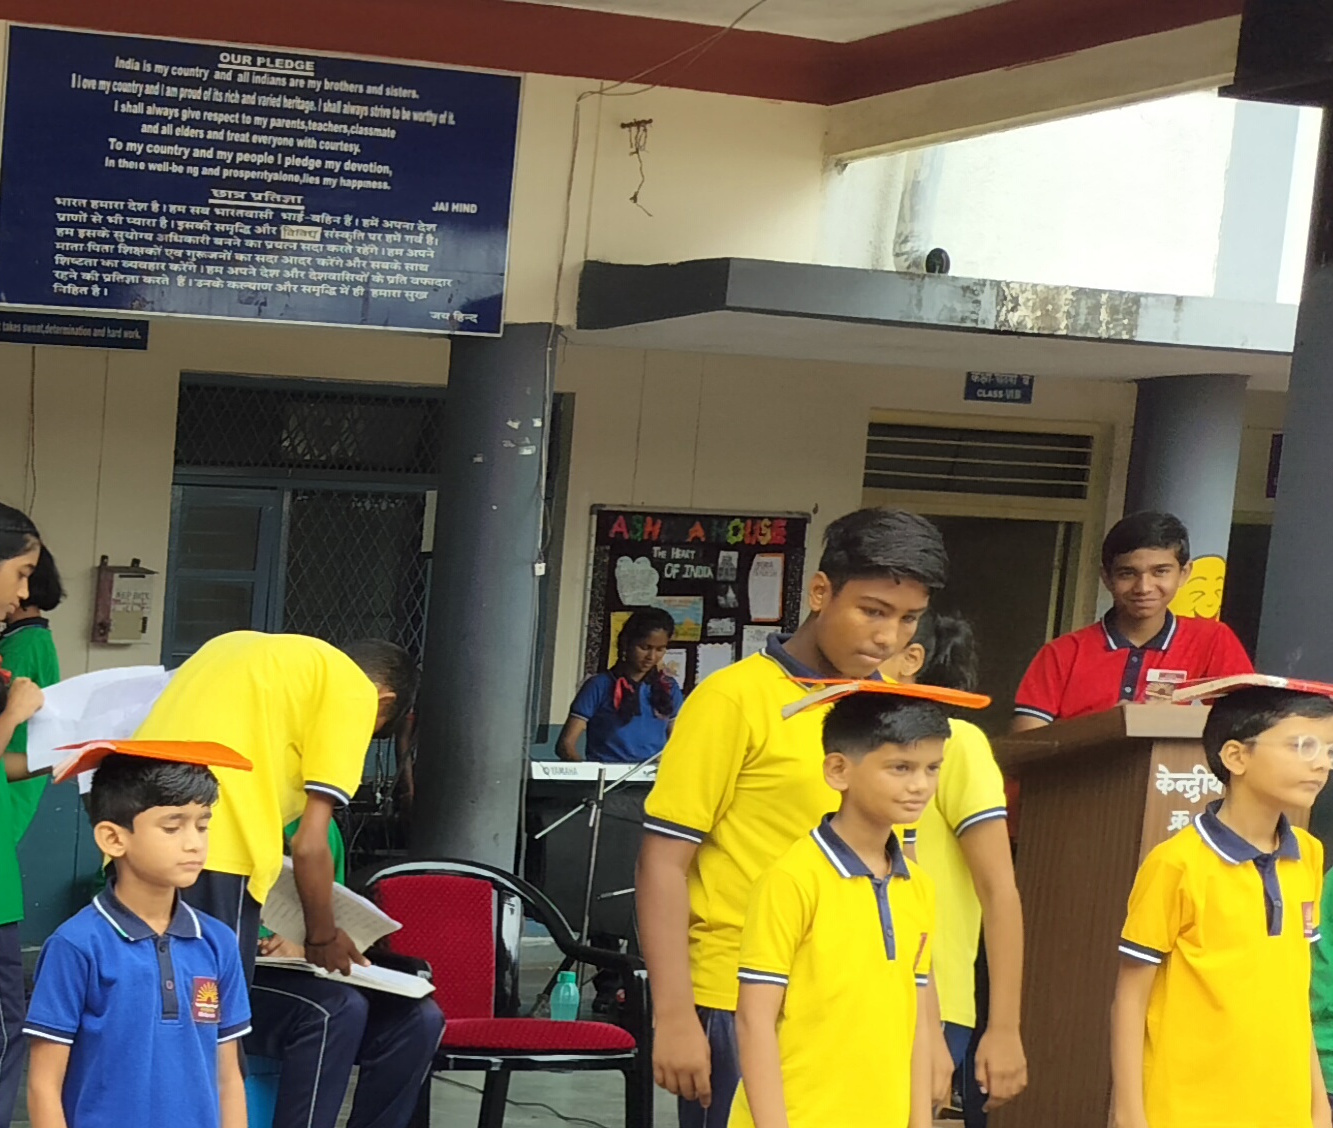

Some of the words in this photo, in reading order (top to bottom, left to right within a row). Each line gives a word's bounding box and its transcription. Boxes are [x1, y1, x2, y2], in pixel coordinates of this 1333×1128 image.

[220, 53, 252, 66] OUR
[256, 56, 315, 71] PLEDGE
[432, 202, 449, 212] JAI
[451, 203, 477, 214] HIND
[976, 388, 1003, 399] CLASS
[671, 547, 697, 560] HEART
[664, 562, 680, 579] OF
[683, 564, 714, 579] INDIA
